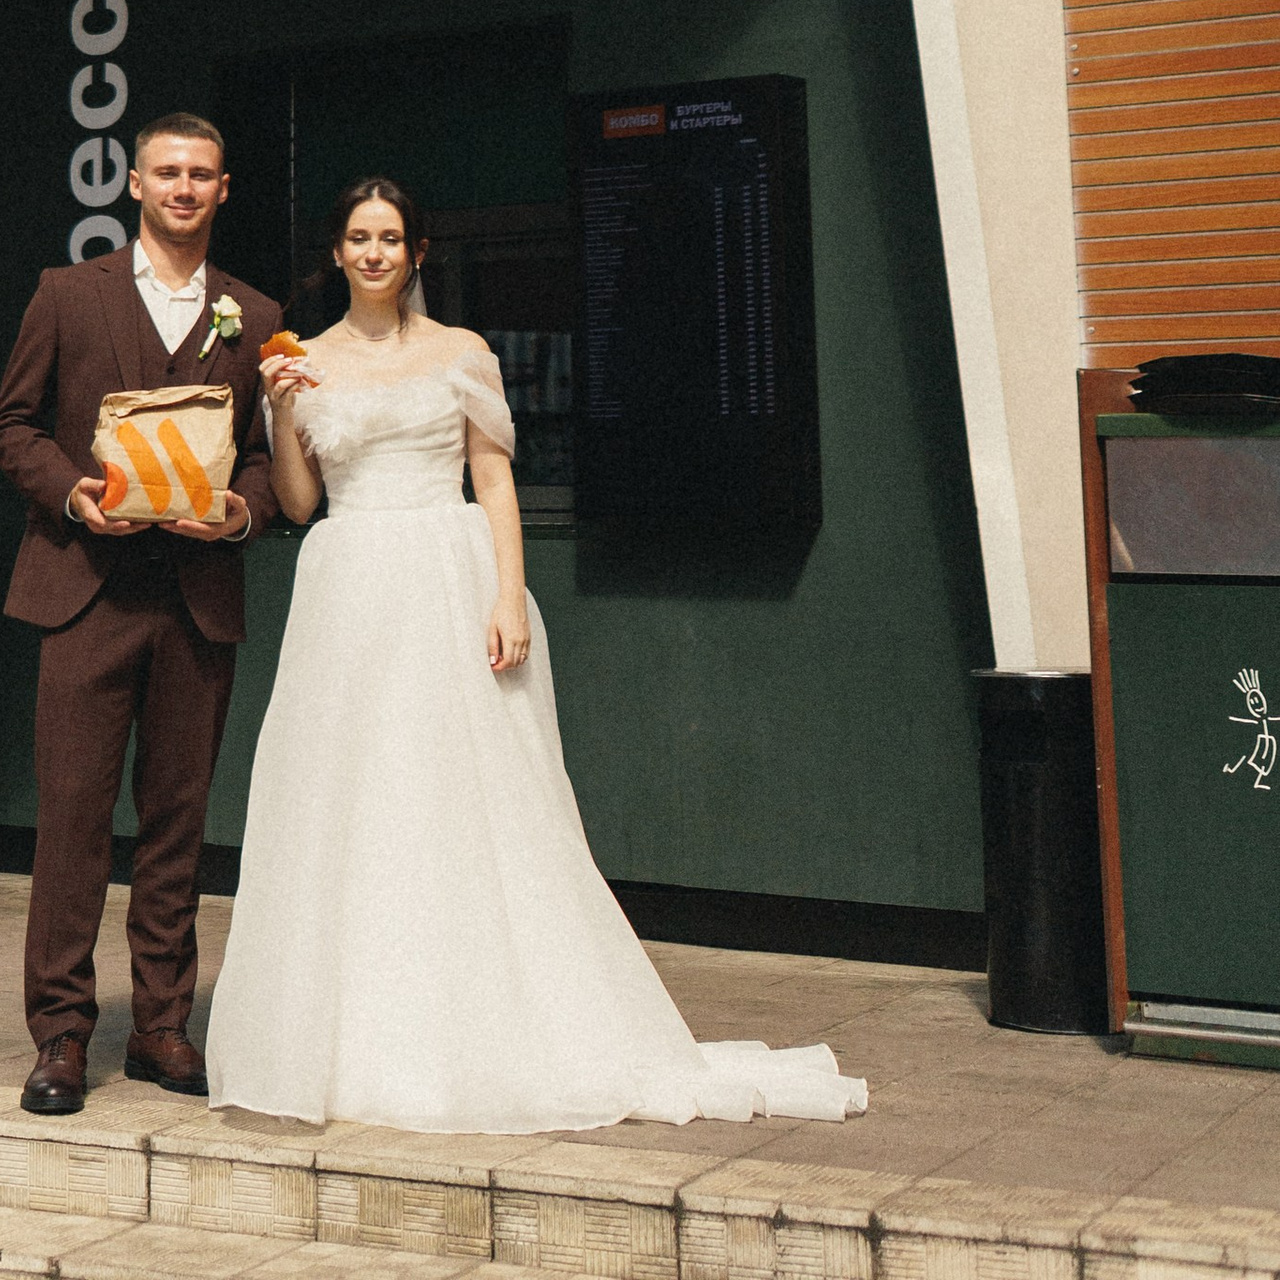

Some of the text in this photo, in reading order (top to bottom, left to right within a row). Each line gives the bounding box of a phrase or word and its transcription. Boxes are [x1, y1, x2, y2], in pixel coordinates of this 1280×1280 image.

[676, 100, 732, 116] БУРГЕРЫ
[609, 113, 659, 129] КОМБО
[670, 114, 743, 130] И СТАРТЕРЫ
